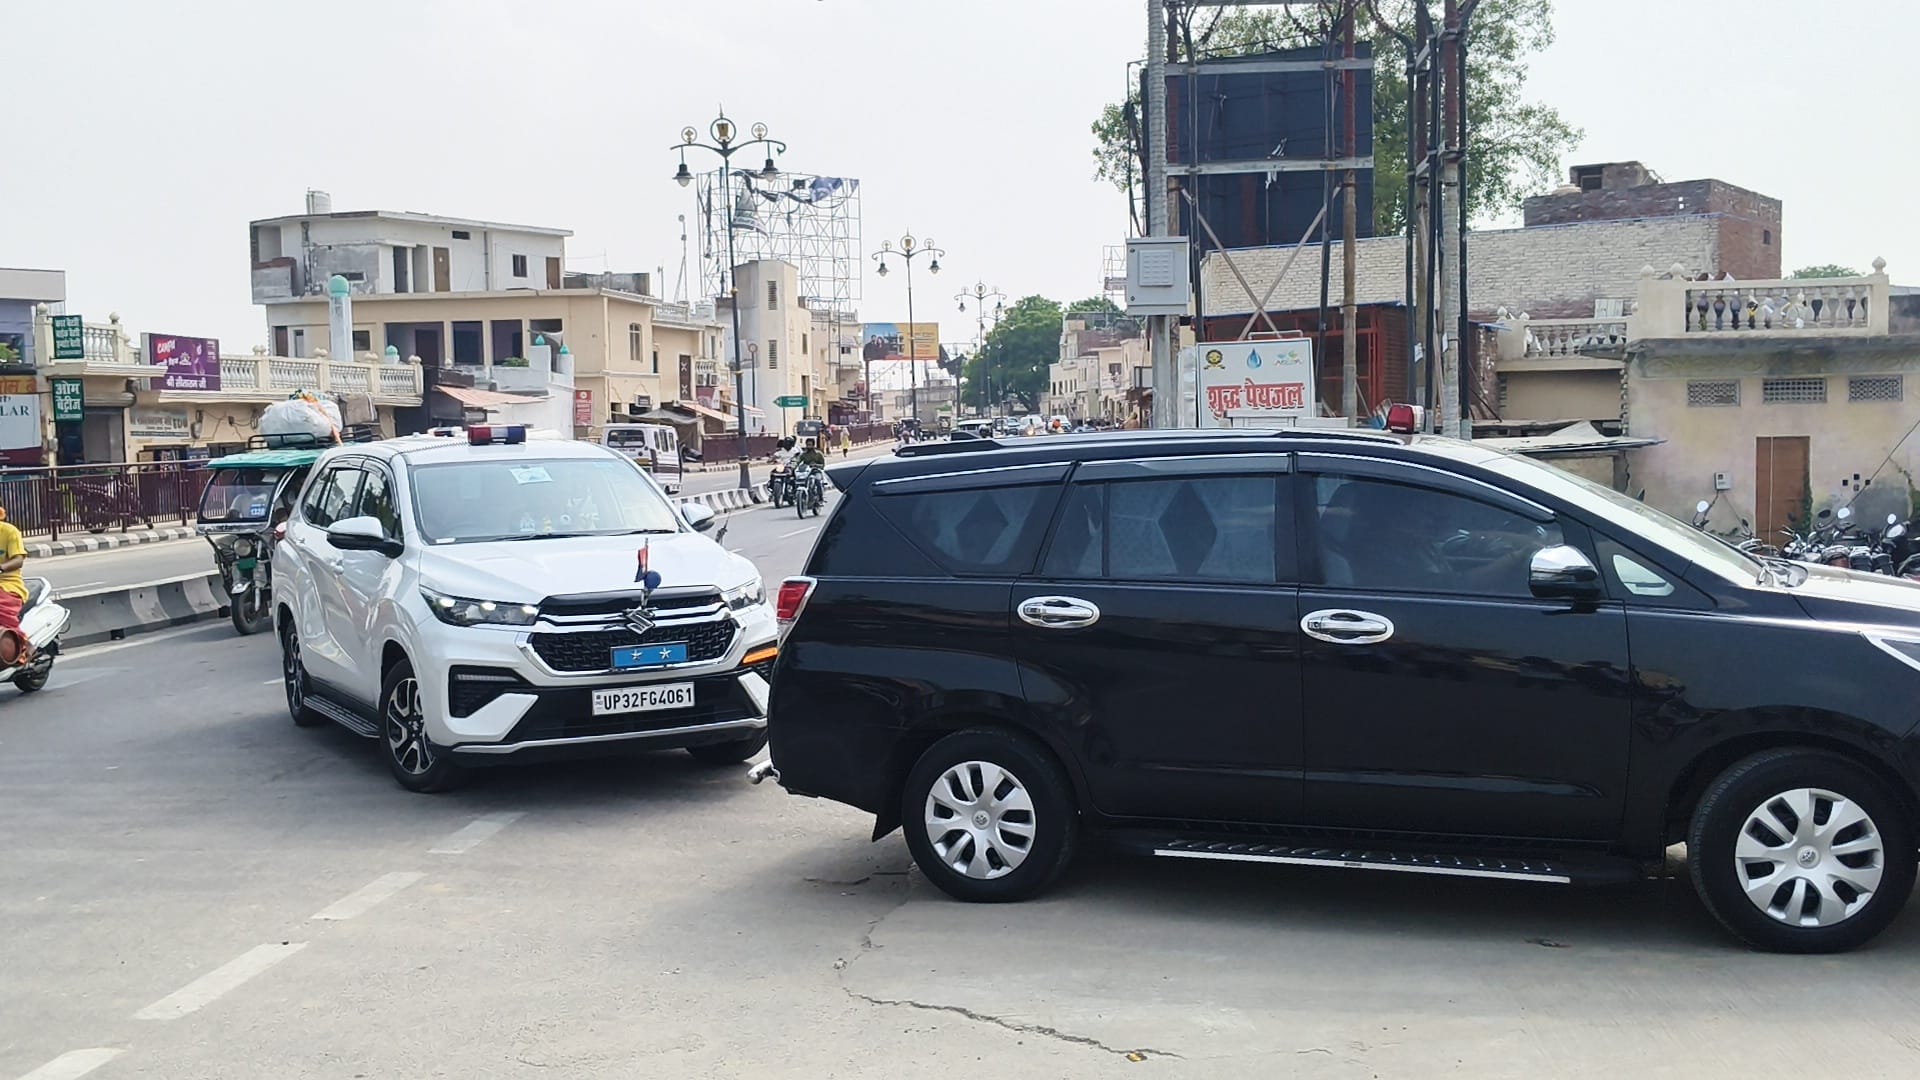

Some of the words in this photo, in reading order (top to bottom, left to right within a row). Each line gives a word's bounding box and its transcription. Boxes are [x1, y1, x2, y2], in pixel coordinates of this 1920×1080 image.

[55, 380, 81, 394] ओम
[1207, 385, 1242, 420] शुद्ध
[1244, 377, 1305, 410] पेयजल
[603, 687, 692, 710] UP32FG4061
